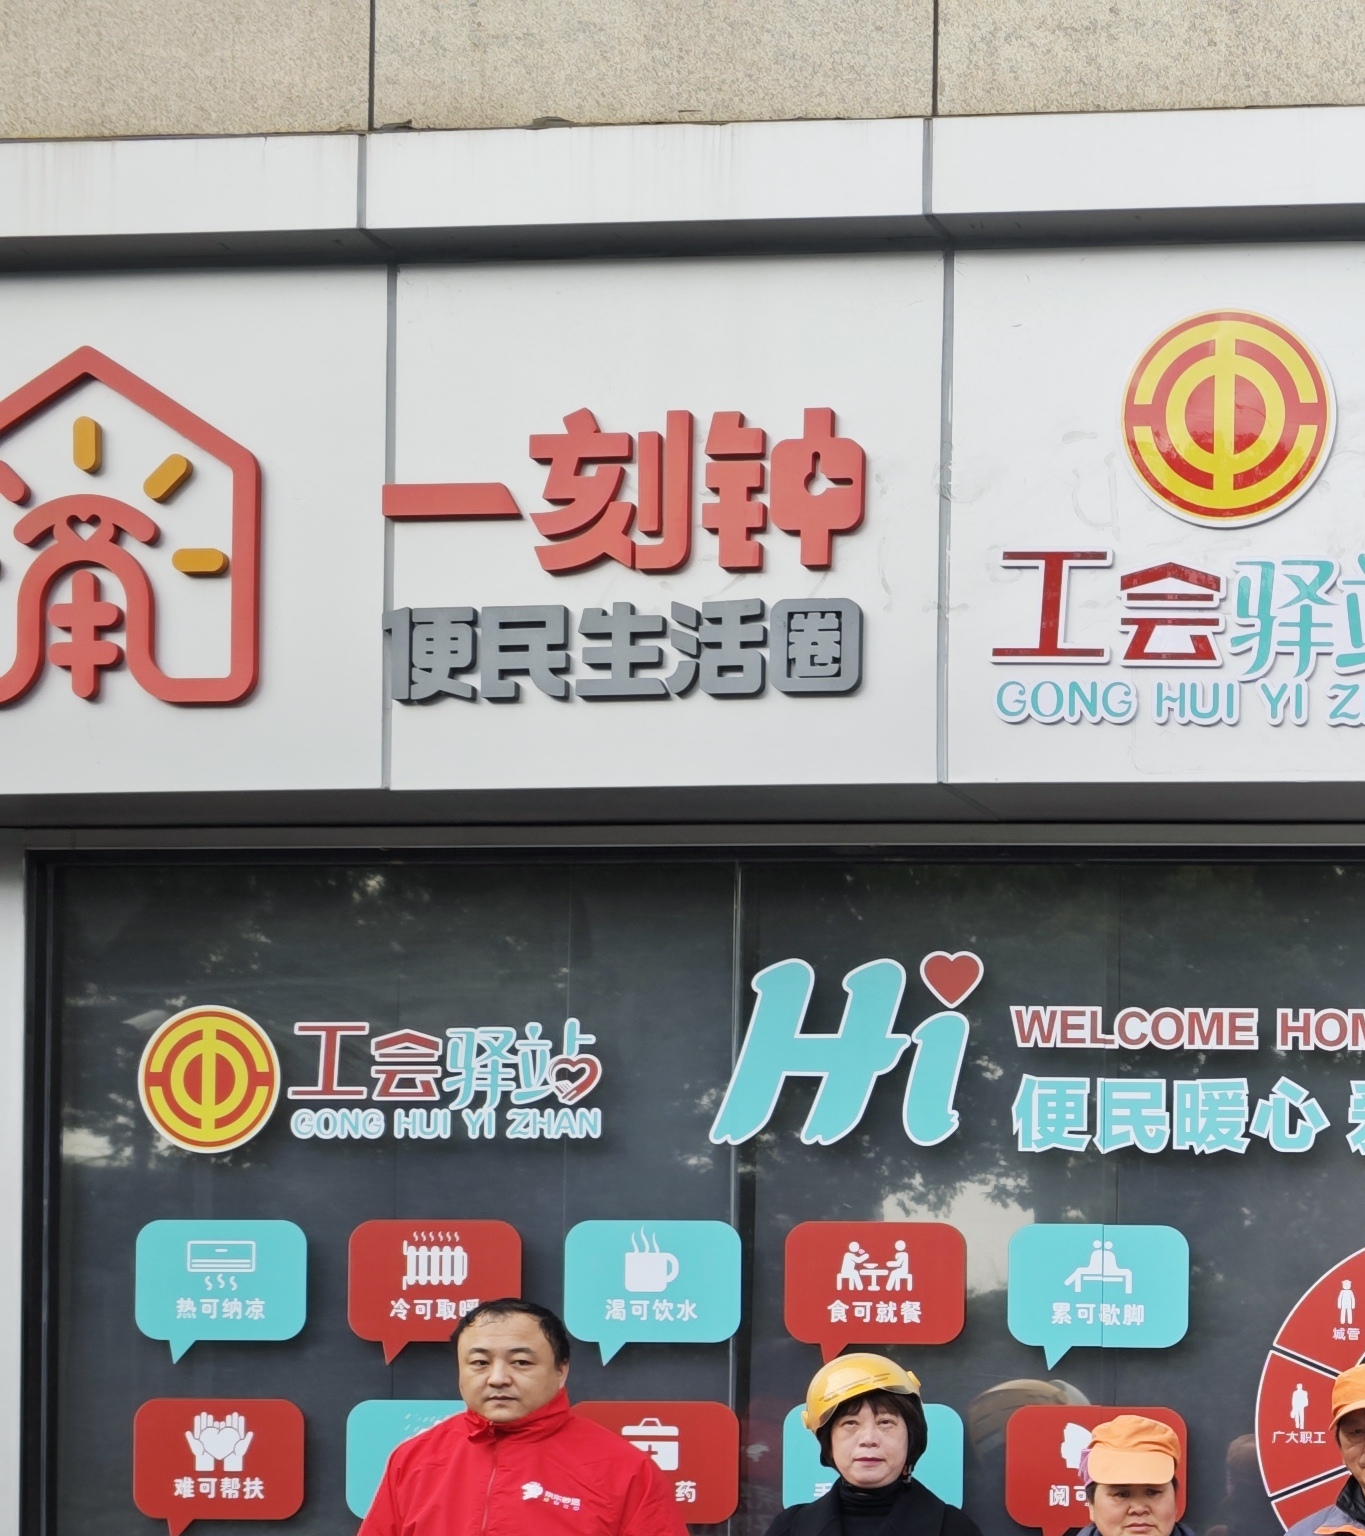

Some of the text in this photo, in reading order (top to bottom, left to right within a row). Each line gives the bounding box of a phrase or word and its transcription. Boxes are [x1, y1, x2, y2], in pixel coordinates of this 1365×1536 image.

[382, 407, 866, 573] 一刻钟
[382, 597, 863, 702] 便民生活圈
[995, 680, 1135, 721] GONG
[1154, 681, 1237, 722] HUI
[1260, 682, 1308, 723] YI
[1010, 1006, 1258, 1050] WELCOME
[288, 1017, 603, 1111] 工会驿站
[708, 950, 984, 1147] Hi
[290, 1108, 602, 1139] GONG HUI YI ZHAN
[1013, 1076, 1329, 1154] 便民暖心
[175, 1297, 266, 1322] 热可纳凉
[604, 1298, 699, 1322] 渴可饮水
[826, 1299, 923, 1325] 食可就餐
[1050, 1301, 1146, 1327] 累可歇脚
[1332, 1327, 1361, 1342] 城管
[1271, 1430, 1326, 1445] 广大职工
[173, 1476, 266, 1501] 难可帮扶
